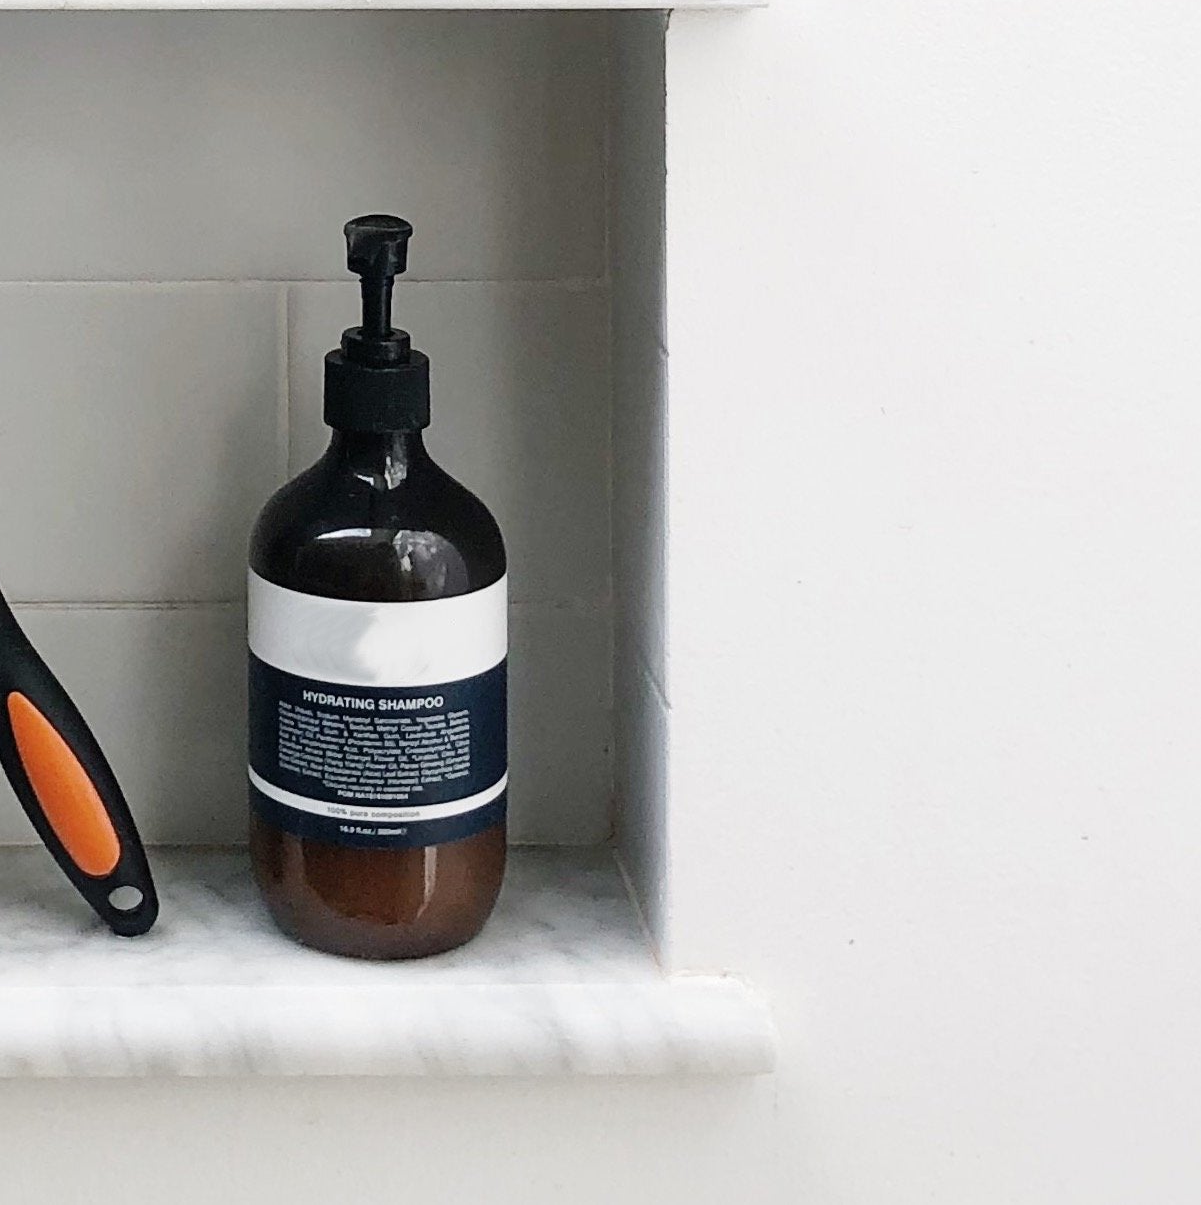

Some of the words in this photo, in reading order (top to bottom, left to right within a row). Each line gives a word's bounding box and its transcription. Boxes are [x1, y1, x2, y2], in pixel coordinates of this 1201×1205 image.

[302, 690, 375, 710] HYDRATING
[378, 696, 444, 710] SHAMPOO
[350, 810, 369, 818] pure
[371, 810, 421, 819] composition
